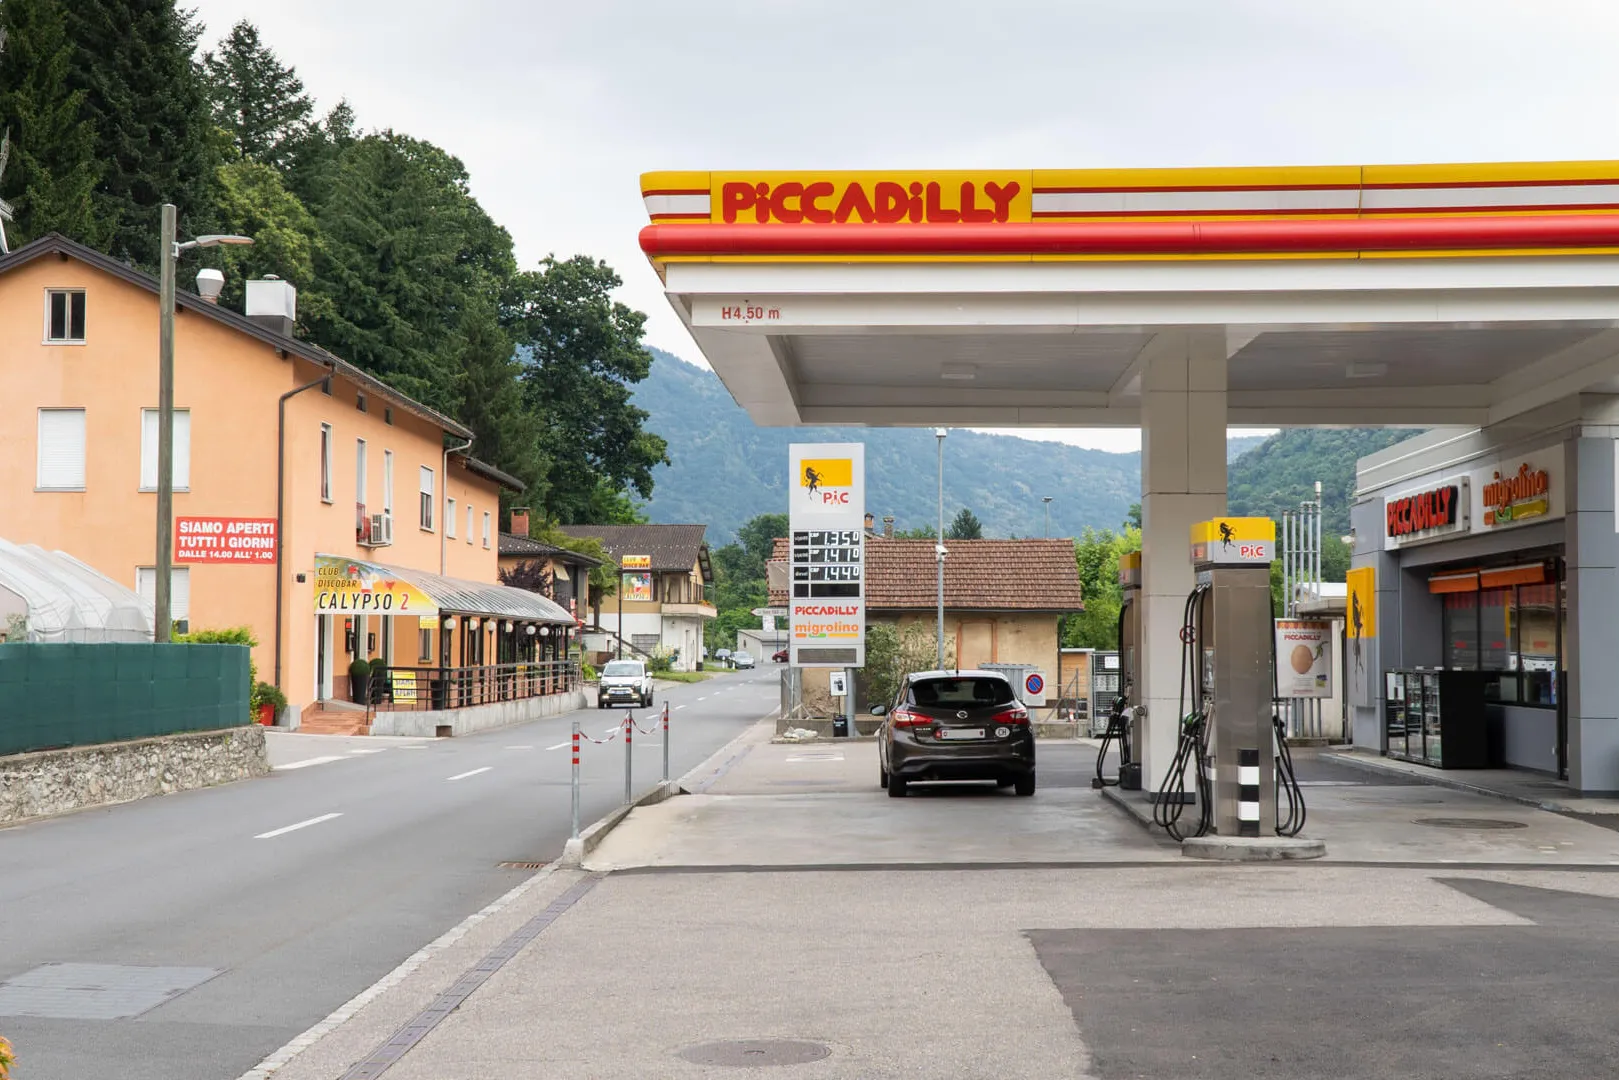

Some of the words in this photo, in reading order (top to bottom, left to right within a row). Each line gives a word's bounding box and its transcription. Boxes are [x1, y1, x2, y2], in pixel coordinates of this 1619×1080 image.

[768, 309, 780, 319] m
[1483, 463, 1548, 512] migrolino
[179, 521, 223, 534] SIAMO
[226, 522, 275, 535] APERTI
[179, 536, 217, 548] TUTTI
[220, 536, 226, 548] I
[228, 537, 274, 549] GIORNI
[178, 550, 207, 558] DALLE
[209, 551, 233, 559] 14.00
[234, 551, 253, 559] ALL'
[254, 551, 273, 560] 1.00
[318, 567, 339, 576] CLUB
[317, 579, 358, 588] DISCOBAR
[318, 592, 393, 610] CALYPSO
[400, 593, 409, 610] 2
[794, 620, 859, 635] migrolino
